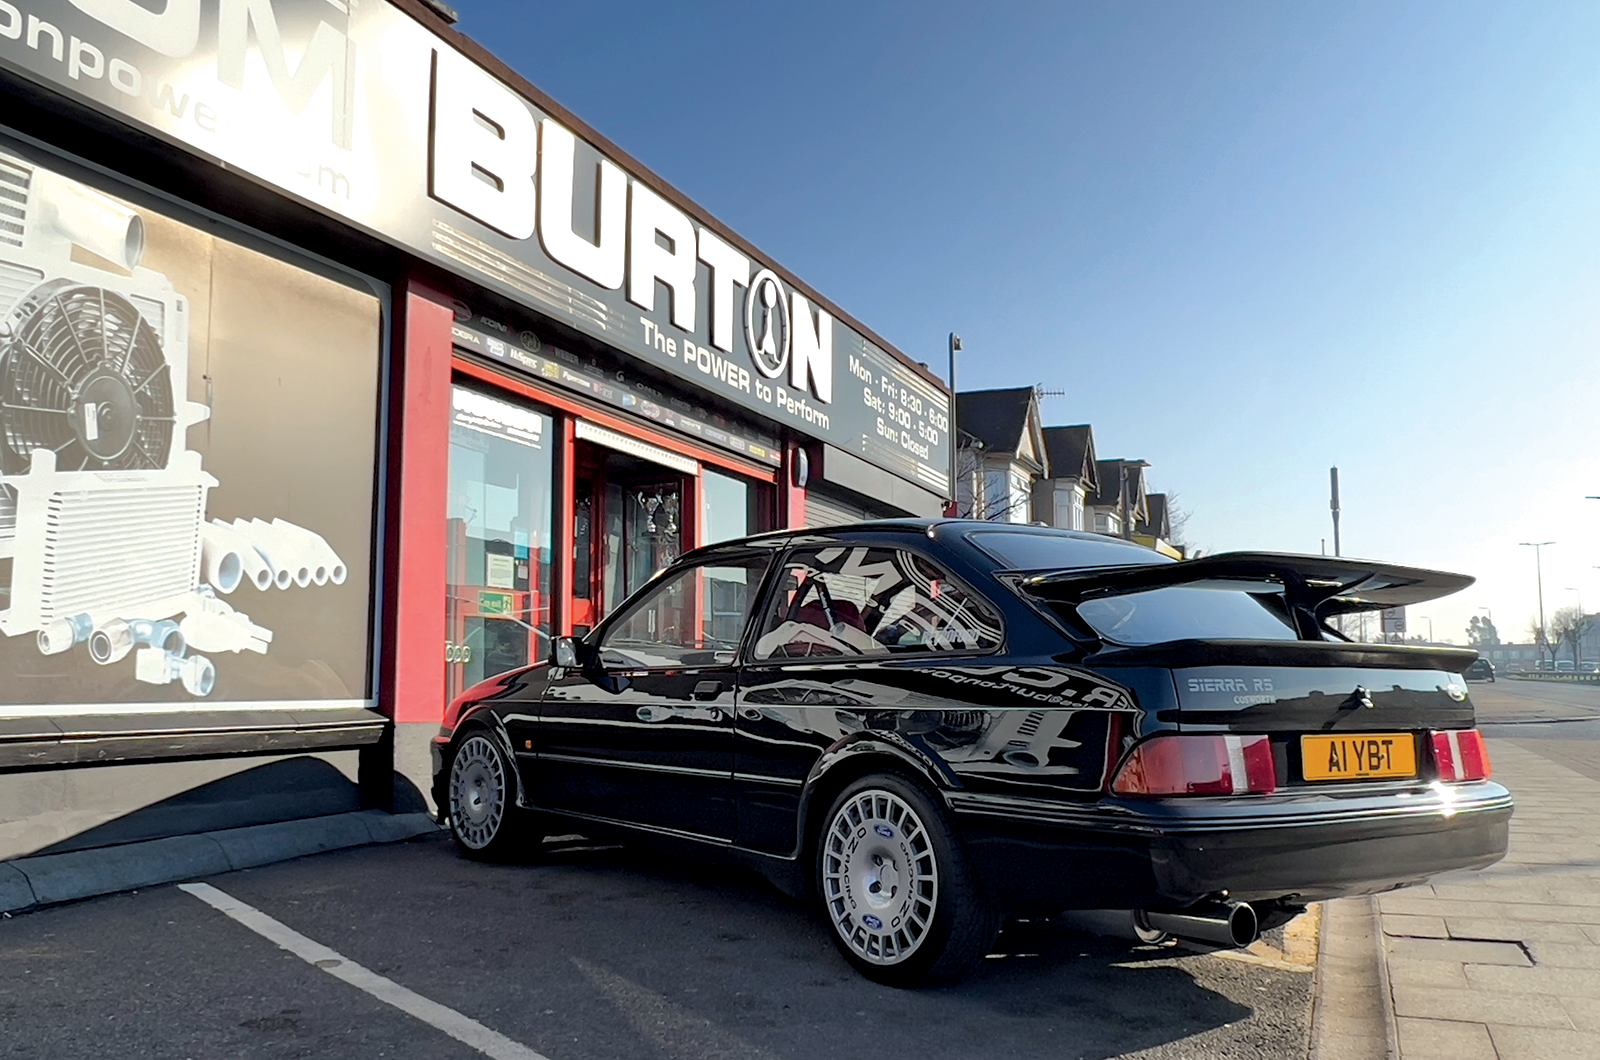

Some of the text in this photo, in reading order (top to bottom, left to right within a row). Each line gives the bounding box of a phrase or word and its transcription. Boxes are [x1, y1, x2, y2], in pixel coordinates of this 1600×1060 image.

[428, 47, 832, 404] BURTON
[640, 316, 830, 430] The POWER to Perform
[849, 354, 872, 384] Mon
[881, 376, 898, 399] Fri:
[900, 388, 922, 416] 8:30
[929, 407, 948, 433] 6:00
[863, 387, 886, 415] Sat:
[888, 402, 911, 429] 9:00
[918, 421, 938, 446] 5:00
[876, 416, 929, 460] Sun: Closed
[1233, 694, 1277, 704] COSWORTH
[1253, 678, 1274, 692] RS
[1352, 739, 1393, 771] YBT
[843, 854, 857, 909] RACING
